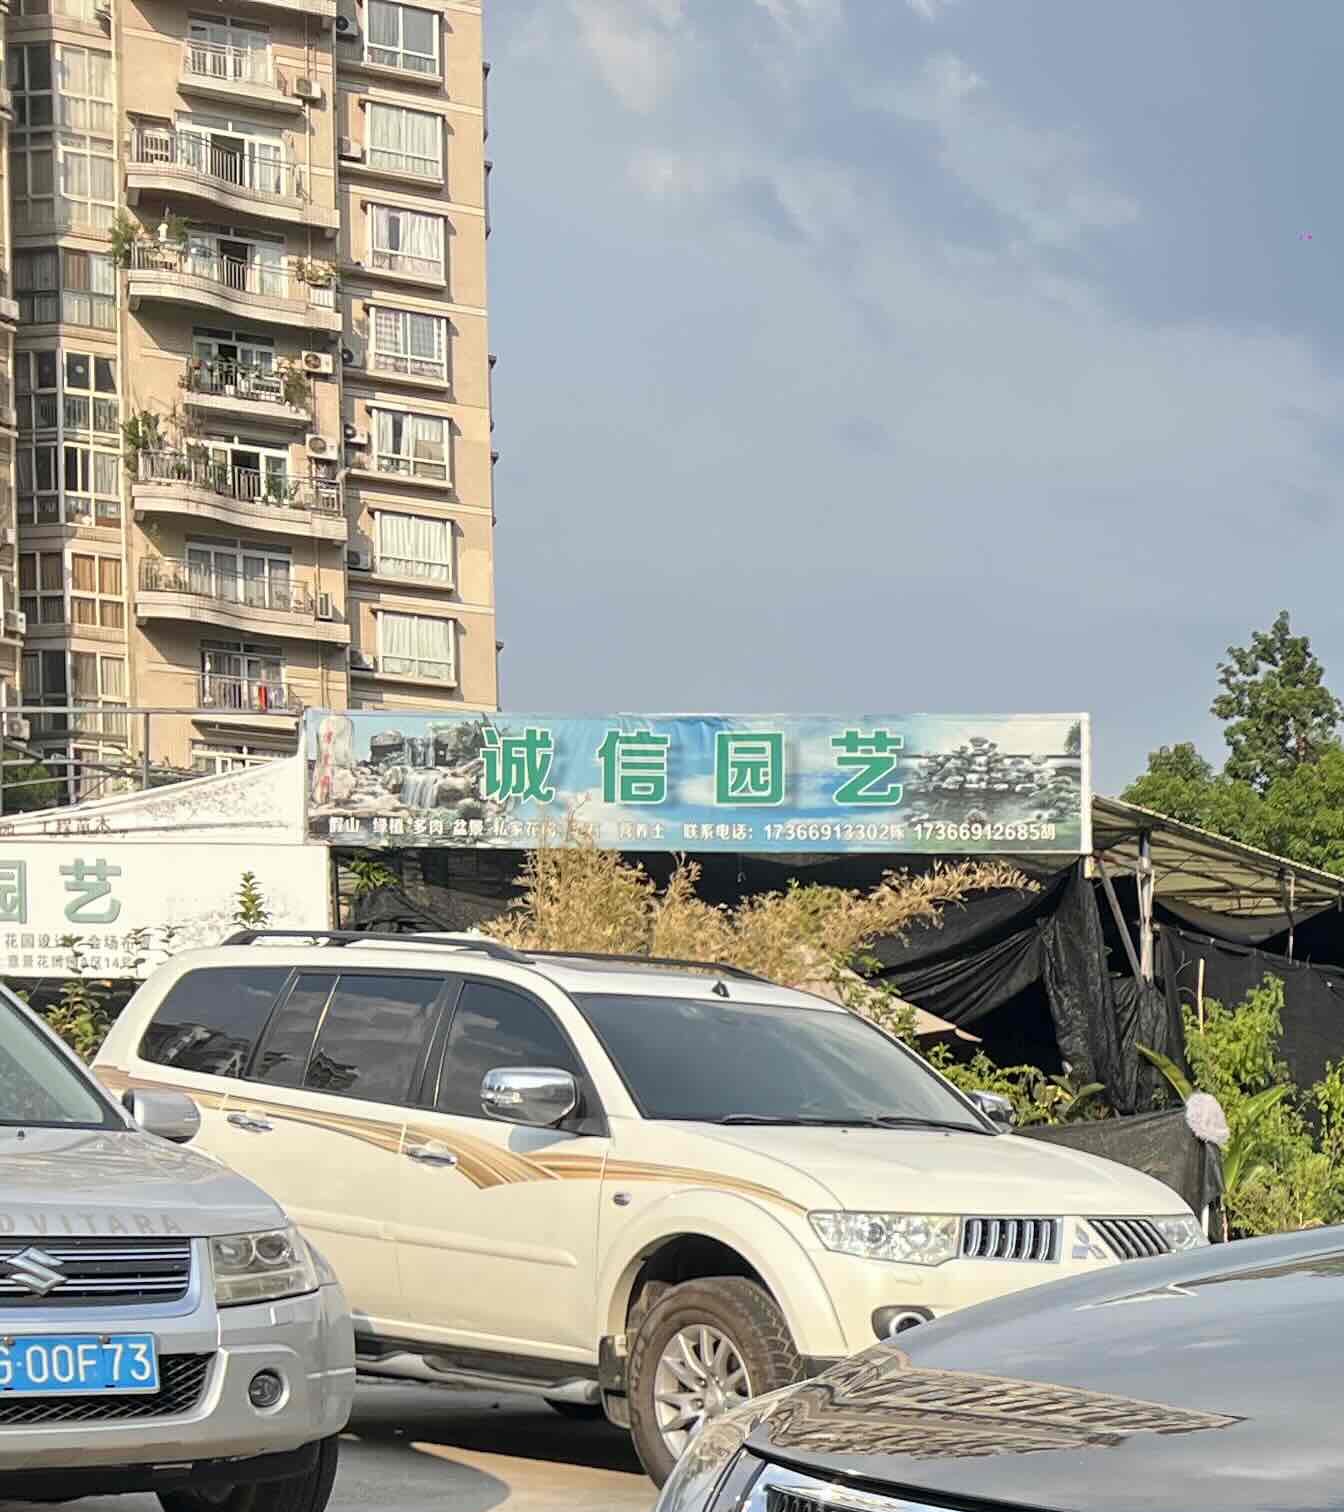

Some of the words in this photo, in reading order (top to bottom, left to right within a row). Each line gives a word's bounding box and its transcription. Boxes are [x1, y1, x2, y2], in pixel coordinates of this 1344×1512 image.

[480, 726, 904, 806] 诚信园艺
[30, 1214, 184, 1234] VITARA
